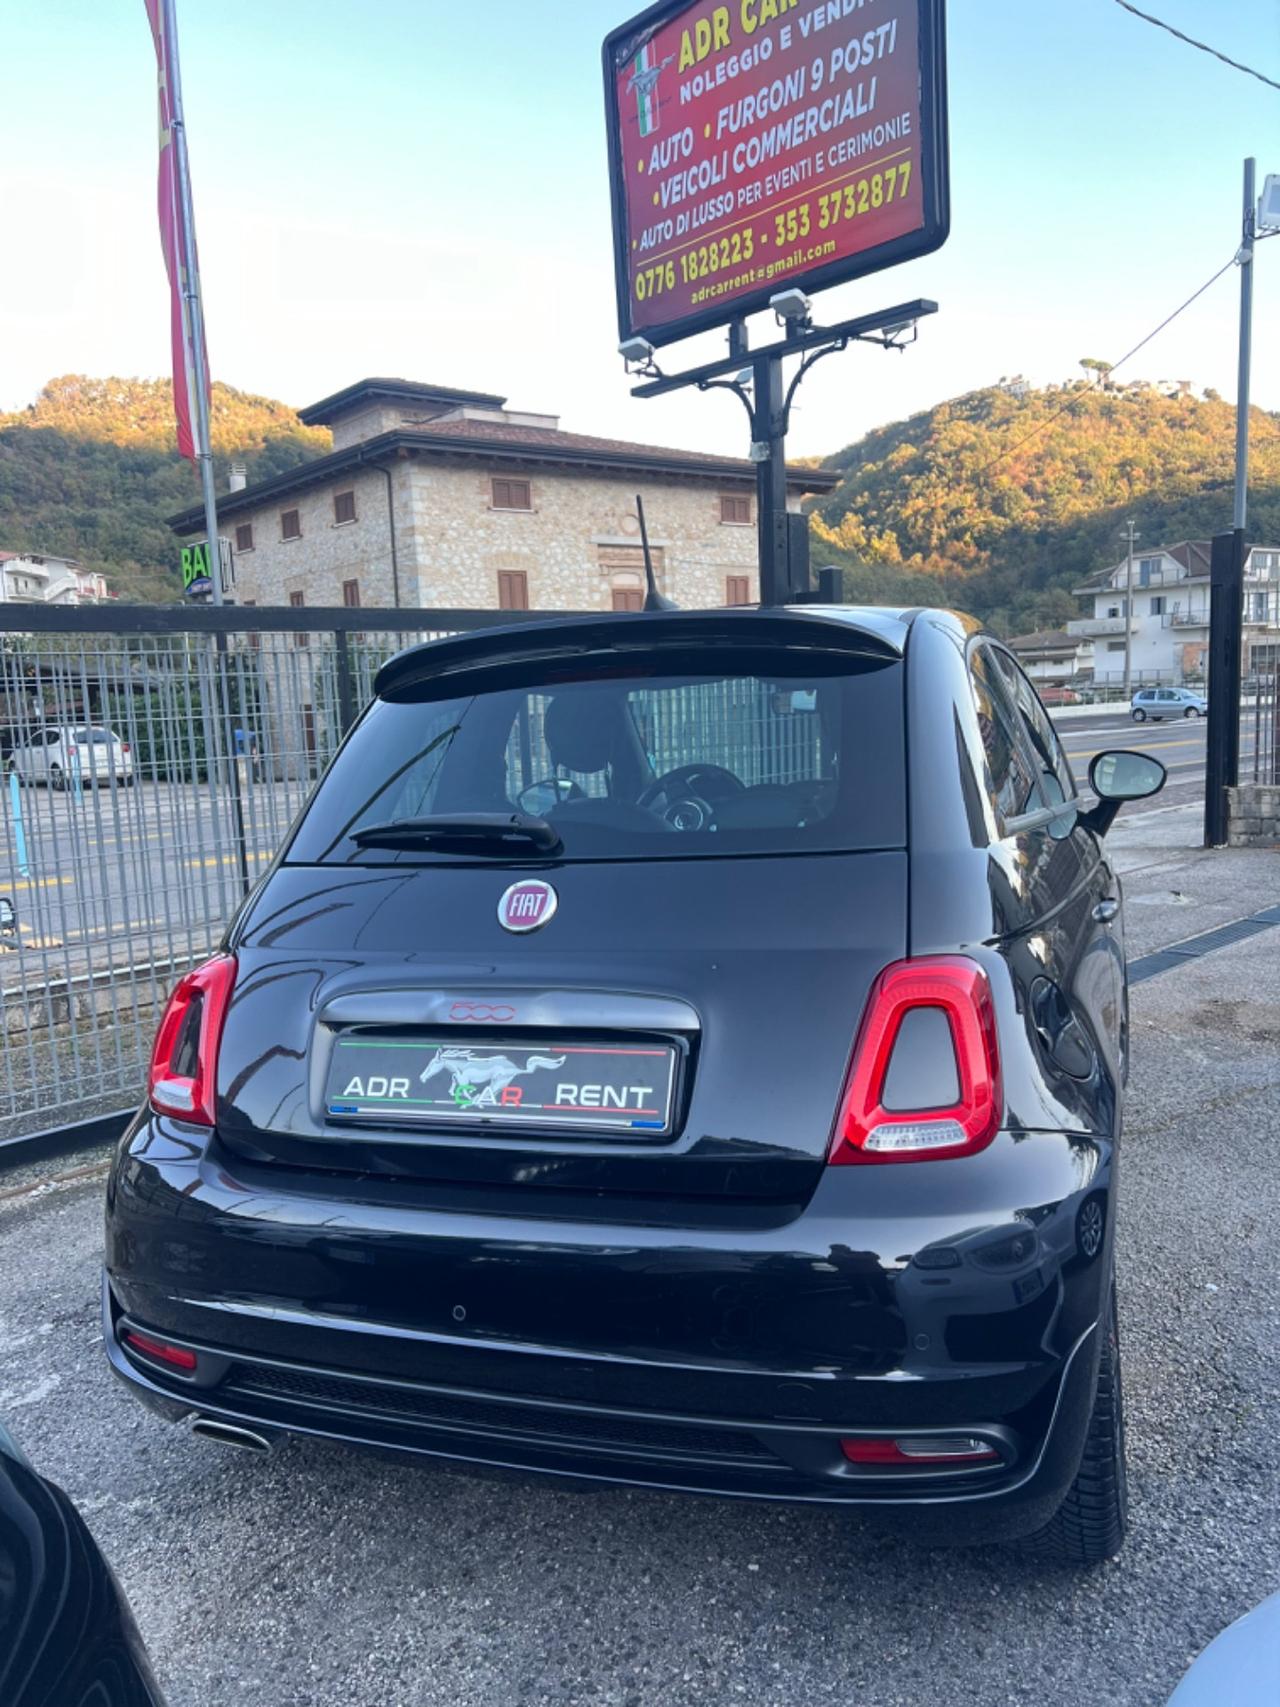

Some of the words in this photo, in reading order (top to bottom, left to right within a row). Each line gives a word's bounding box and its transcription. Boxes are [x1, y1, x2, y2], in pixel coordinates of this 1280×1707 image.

[678, 6, 731, 73] ADR
[741, 0, 798, 34] CA
[680, 37, 773, 105] NOLEGGIO
[780, 24, 792, 50] E
[716, 66, 806, 140] FURGONI
[811, 58, 824, 91] 9
[829, 18, 898, 83] POSTI
[648, 127, 694, 175] AUTO
[660, 151, 728, 209] VEICOLI
[732, 76, 878, 174] COMMERCIALI
[640, 220, 673, 251] AUTO
[676, 211, 690, 236] DI
[692, 193, 734, 222] LUSSO
[738, 185, 762, 209] PER
[765, 160, 813, 196] EVENTI
[815, 152, 825, 173] E
[827, 112, 912, 167] CERIMONIE
[636, 261, 675, 301] 0776
[680, 228, 754, 283] 1828223
[775, 203, 811, 246] 353
[818, 160, 913, 229] 3732877
[691, 240, 837, 304] adrcarrent@gmail.com
[509, 893, 546, 917] FIAT
[449, 1002, 516, 1022] 500
[343, 1076, 410, 1098] ADR
[455, 1085, 523, 1107] CAR
[554, 1084, 654, 1109] RENT
